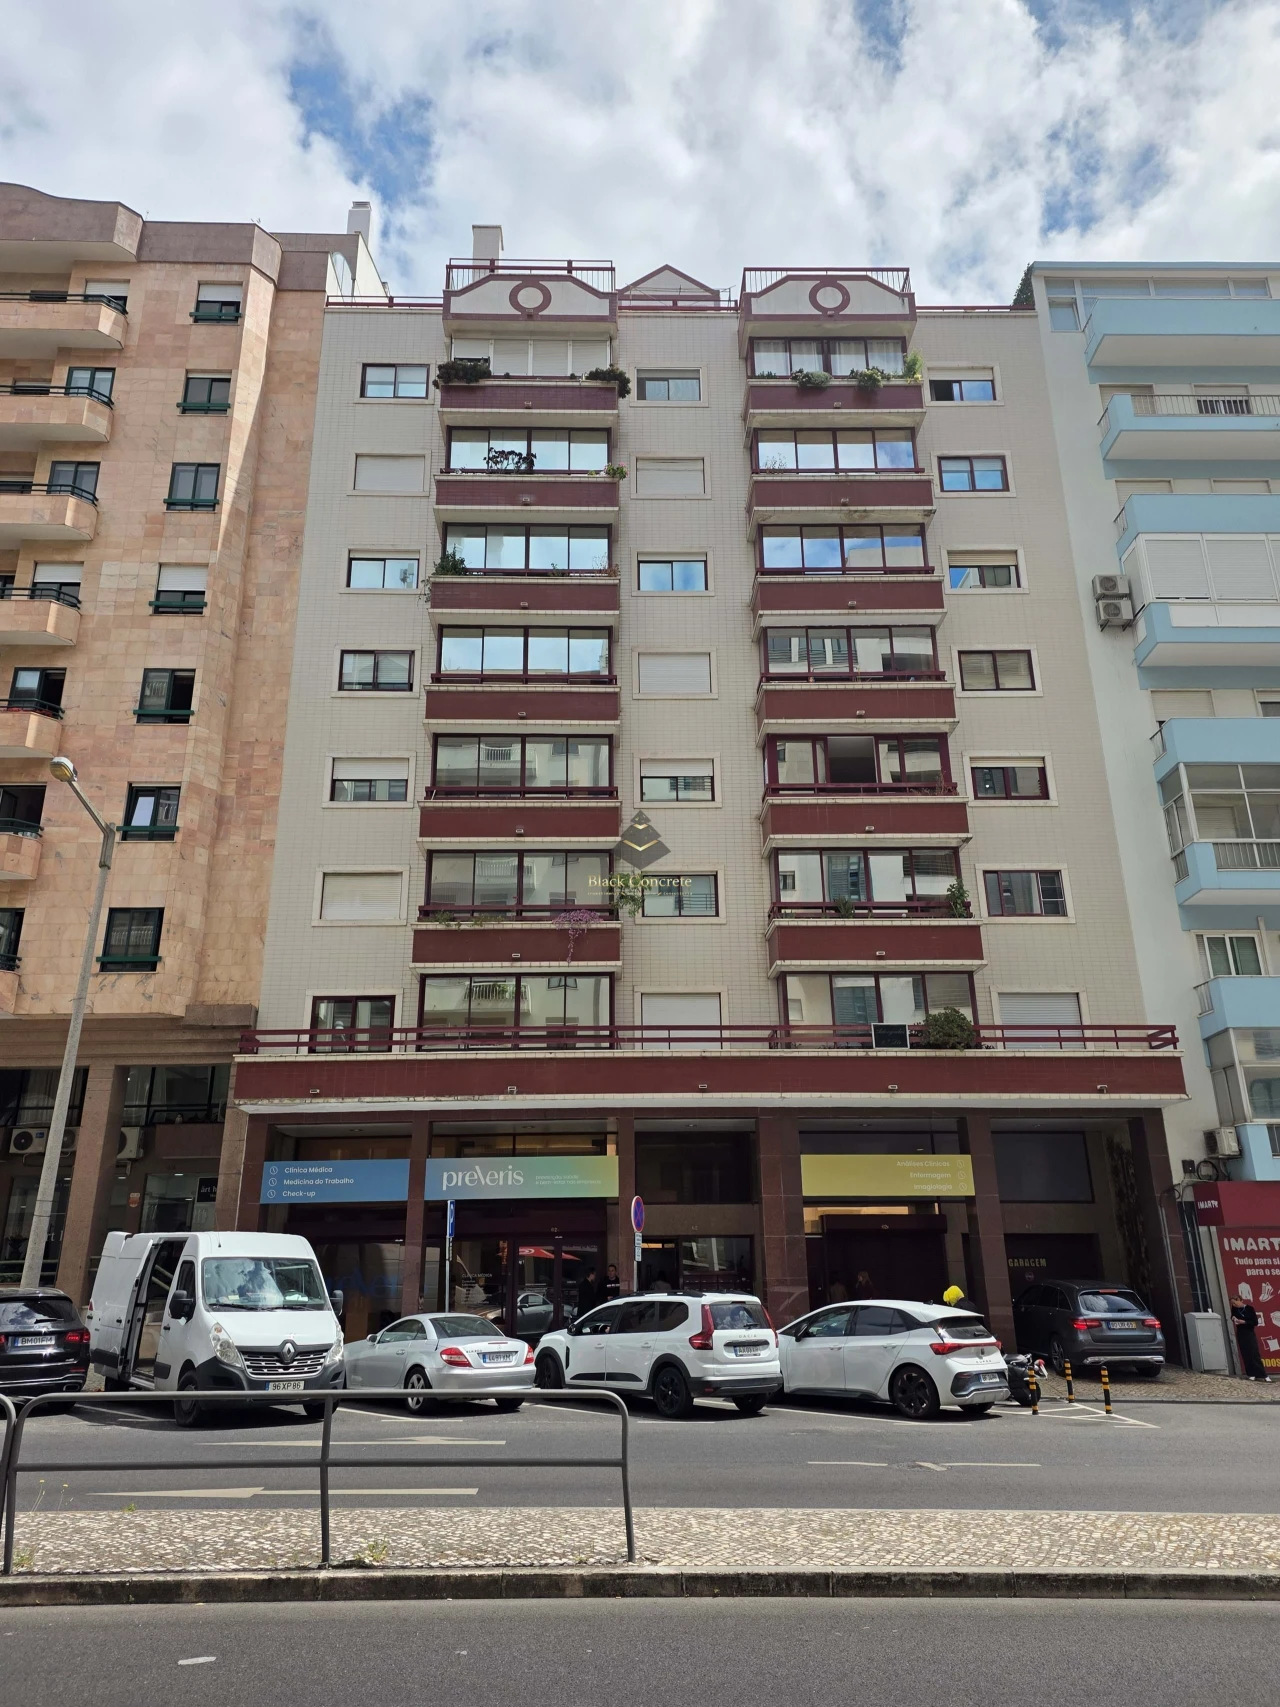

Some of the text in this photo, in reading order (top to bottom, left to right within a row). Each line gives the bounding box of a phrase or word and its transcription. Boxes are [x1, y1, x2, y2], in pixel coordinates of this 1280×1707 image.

[909, 1172, 951, 1180] Enfermagem
[282, 1190, 316, 1198] Check-up
[1008, 1258, 1047, 1267] GARAGEM
[1234, 1256, 1254, 1265] Tudo
[1254, 1258, 1272, 1266] para
[1246, 1268, 1264, 1277] para
[1264, 1268, 1271, 1276] o
